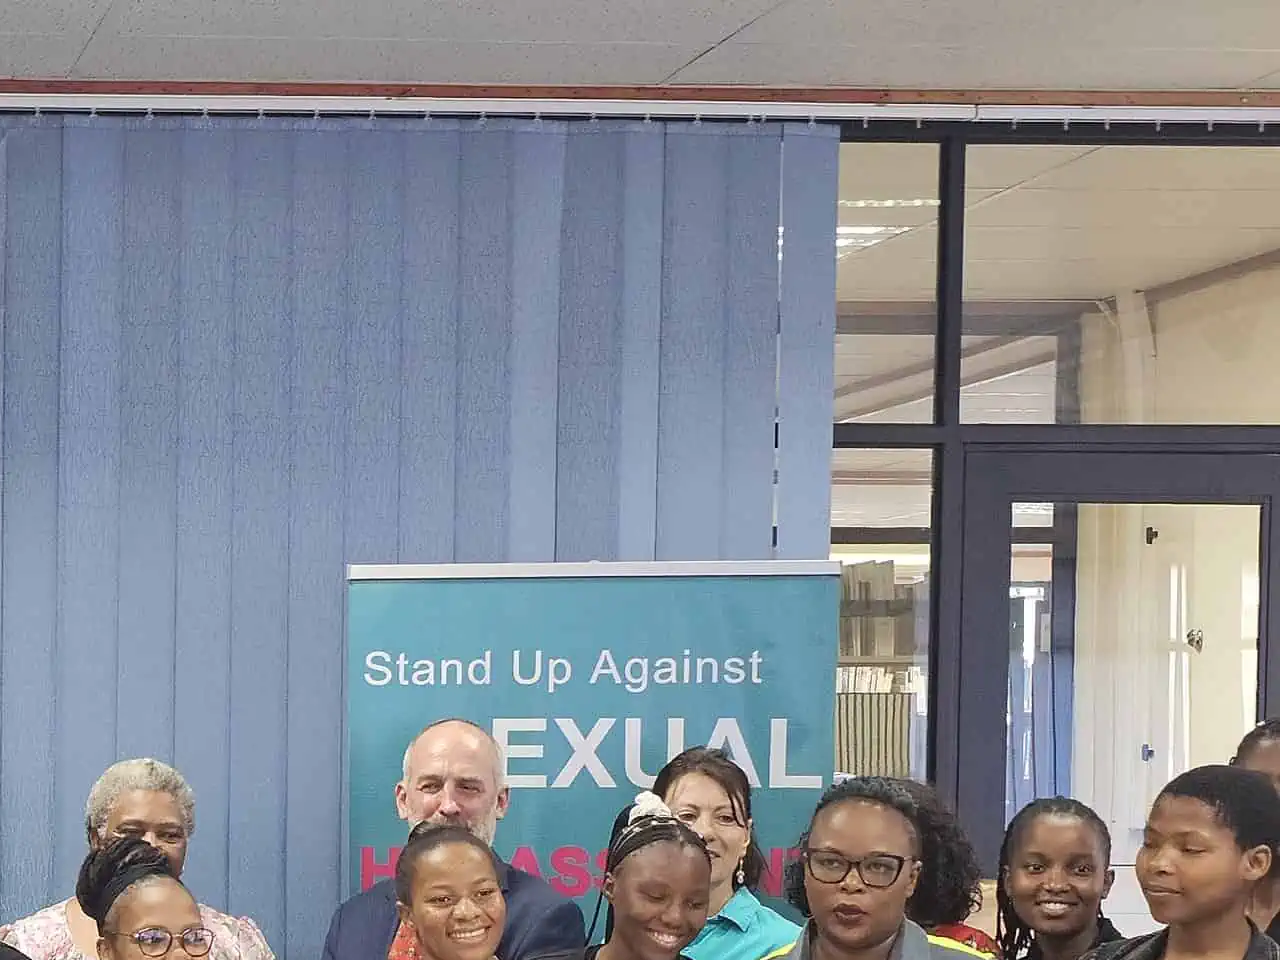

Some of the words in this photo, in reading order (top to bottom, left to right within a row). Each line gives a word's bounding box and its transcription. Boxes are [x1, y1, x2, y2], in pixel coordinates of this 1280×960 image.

[363, 650, 491, 686] Stand
[512, 649, 572, 693] Up
[589, 649, 763, 693] Against
[491, 717, 823, 789] EXUAL
